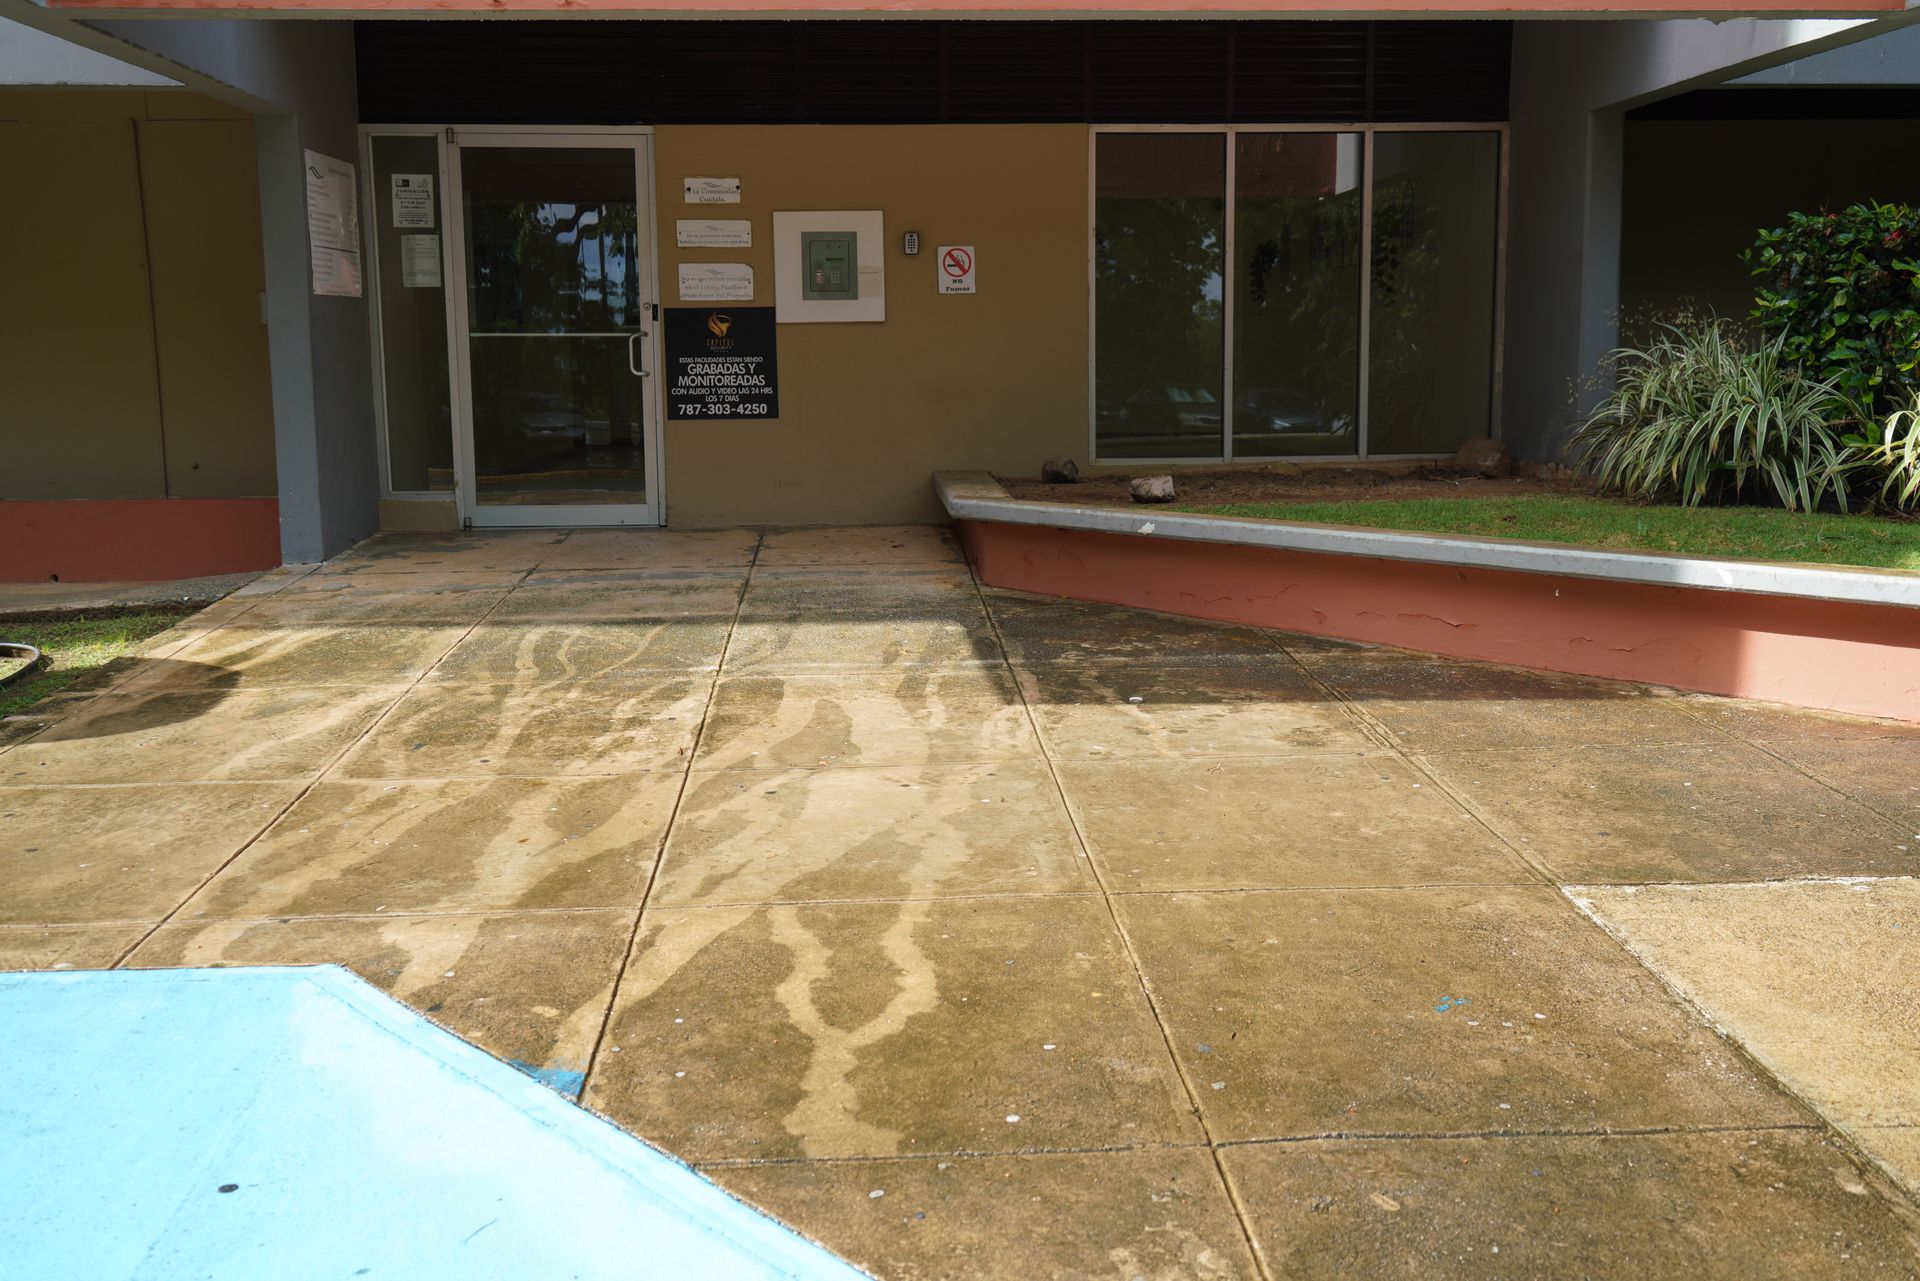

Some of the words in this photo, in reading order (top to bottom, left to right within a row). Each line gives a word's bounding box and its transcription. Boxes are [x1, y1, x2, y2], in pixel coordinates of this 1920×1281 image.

[687, 363, 746, 374] GRABADAS
[748, 363, 756, 374] Y
[678, 375, 766, 387] MONITOREADAS
[678, 404, 768, 415] 787-303-4250
